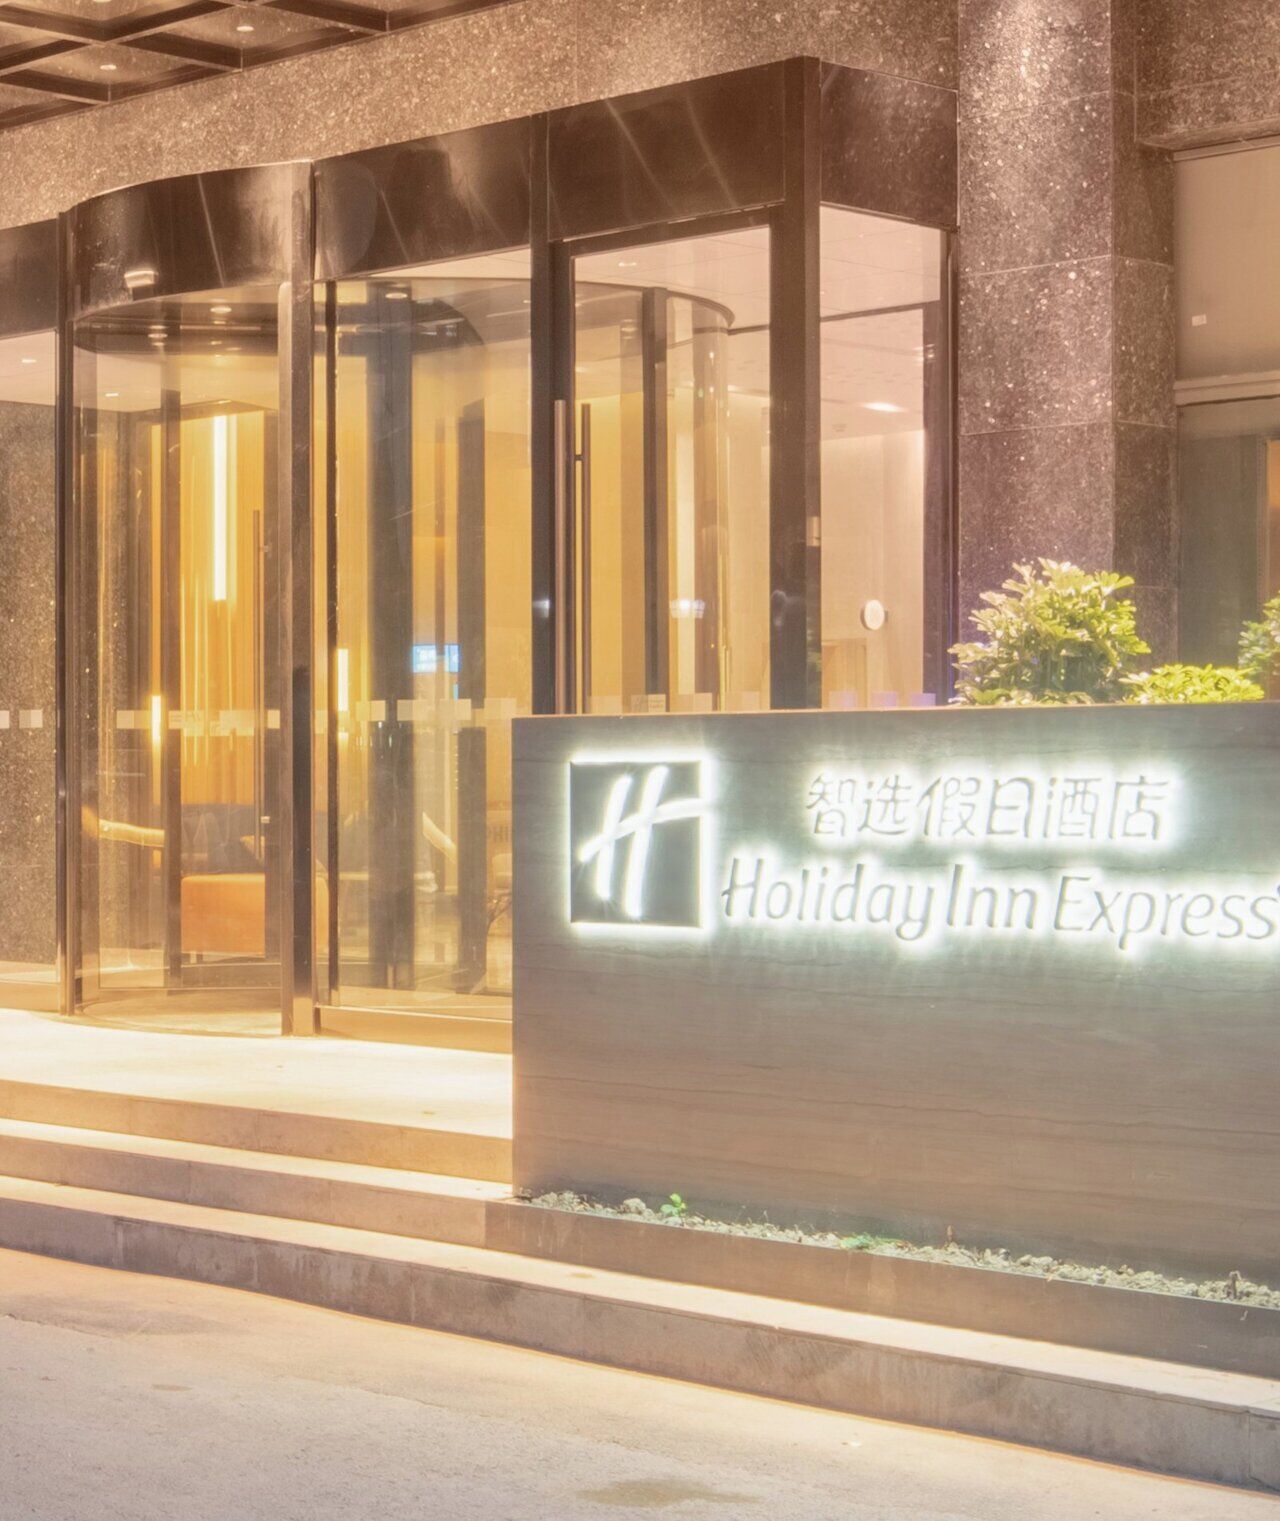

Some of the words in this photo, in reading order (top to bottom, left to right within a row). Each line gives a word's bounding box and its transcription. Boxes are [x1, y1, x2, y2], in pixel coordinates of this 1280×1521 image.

[805, 773, 1171, 841] 智选假日酒店
[721, 857, 936, 941] Holiday
[946, 863, 1035, 930] Inn
[1053, 874, 1280, 950] Express
